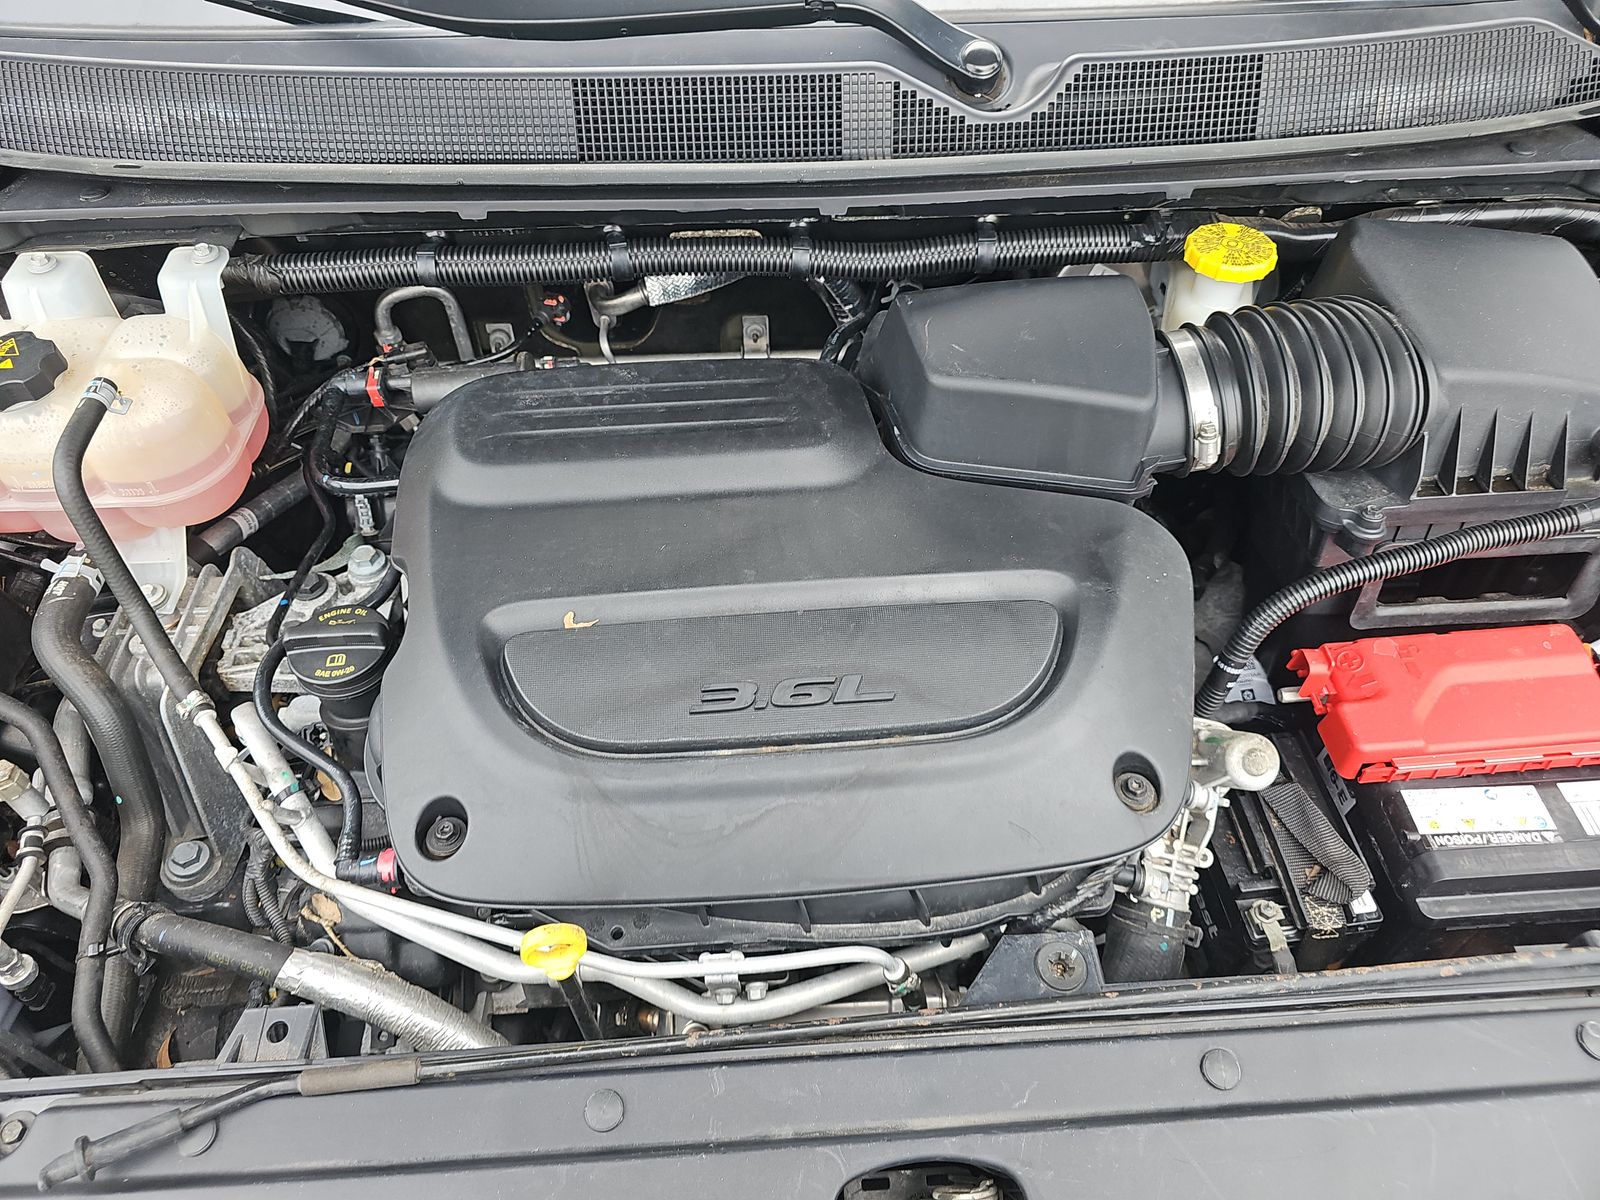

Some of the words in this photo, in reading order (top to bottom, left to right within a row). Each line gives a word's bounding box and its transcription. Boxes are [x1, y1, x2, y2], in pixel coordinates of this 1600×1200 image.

[318, 607, 352, 622] ENGINE
[354, 608, 368, 617] OIL
[314, 668, 331, 678] SAE
[331, 665, 355, 678] 0W-20
[688, 673, 896, 715] 3.6L
